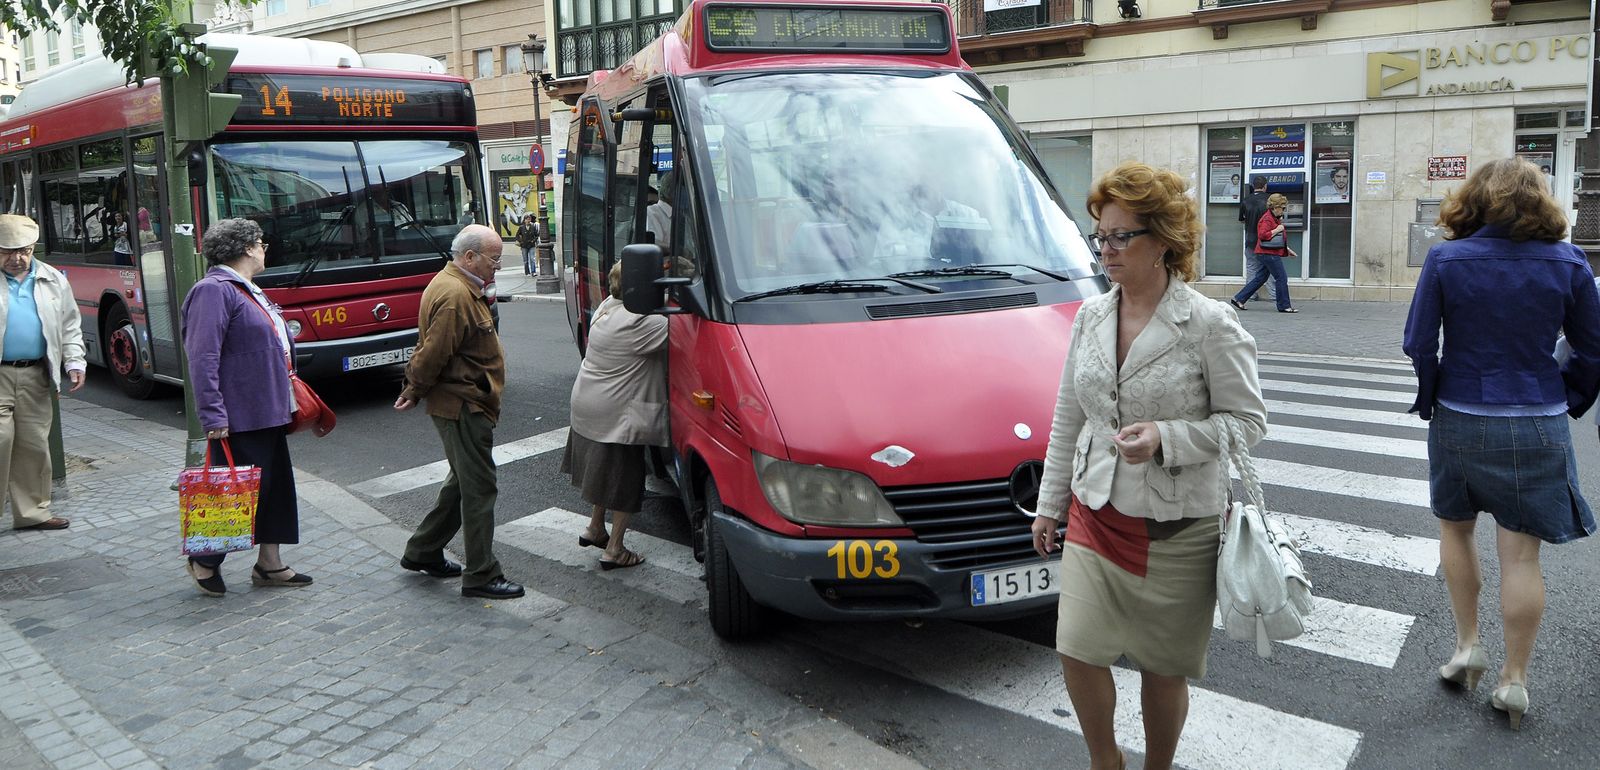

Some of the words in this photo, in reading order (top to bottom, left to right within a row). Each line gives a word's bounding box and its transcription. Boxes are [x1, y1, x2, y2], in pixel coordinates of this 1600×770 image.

[774, 14, 928, 38] ENCARNACION
[1426, 41, 1537, 69] BANCO
[322, 86, 406, 104] POLIGONO
[1426, 77, 1515, 96] ANDALUCÍA
[260, 84, 292, 116] 14
[339, 102, 393, 117] NORTE
[1252, 155, 1304, 166] TELEBANCO
[312, 306, 348, 326] 146
[352, 356, 377, 368] 8025
[827, 539, 901, 580] 103
[993, 567, 1050, 599] 1513
